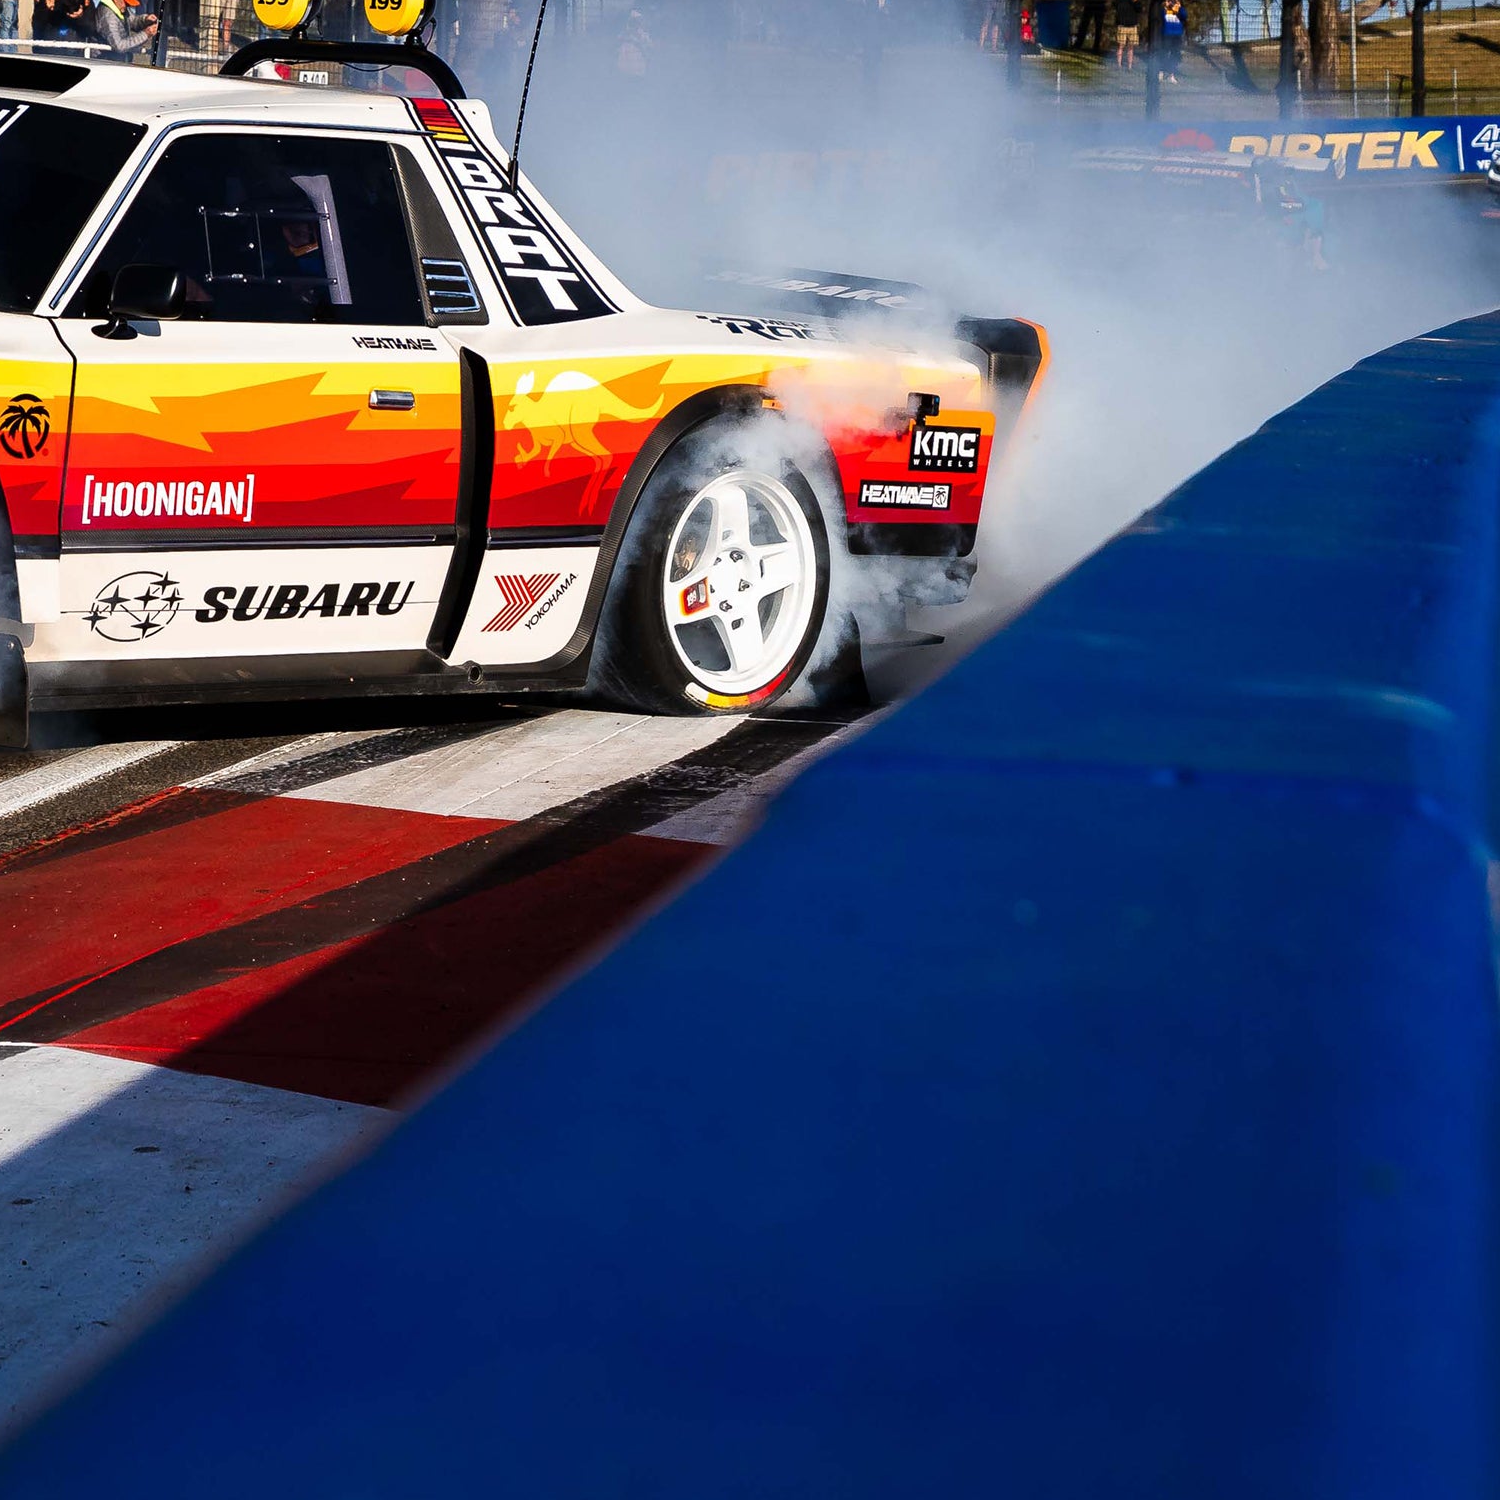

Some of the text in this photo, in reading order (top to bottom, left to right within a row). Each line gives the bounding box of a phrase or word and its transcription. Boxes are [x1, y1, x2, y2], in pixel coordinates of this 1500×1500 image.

[445, 156, 580, 311] BRAT
[352, 337, 437, 350] HEATWAVE
[913, 458, 974, 468] WHEELS
[861, 484, 934, 505] HEATWAVE
[194, 580, 415, 623] SUBARU
[524, 573, 577, 630] YOKOHAMA
